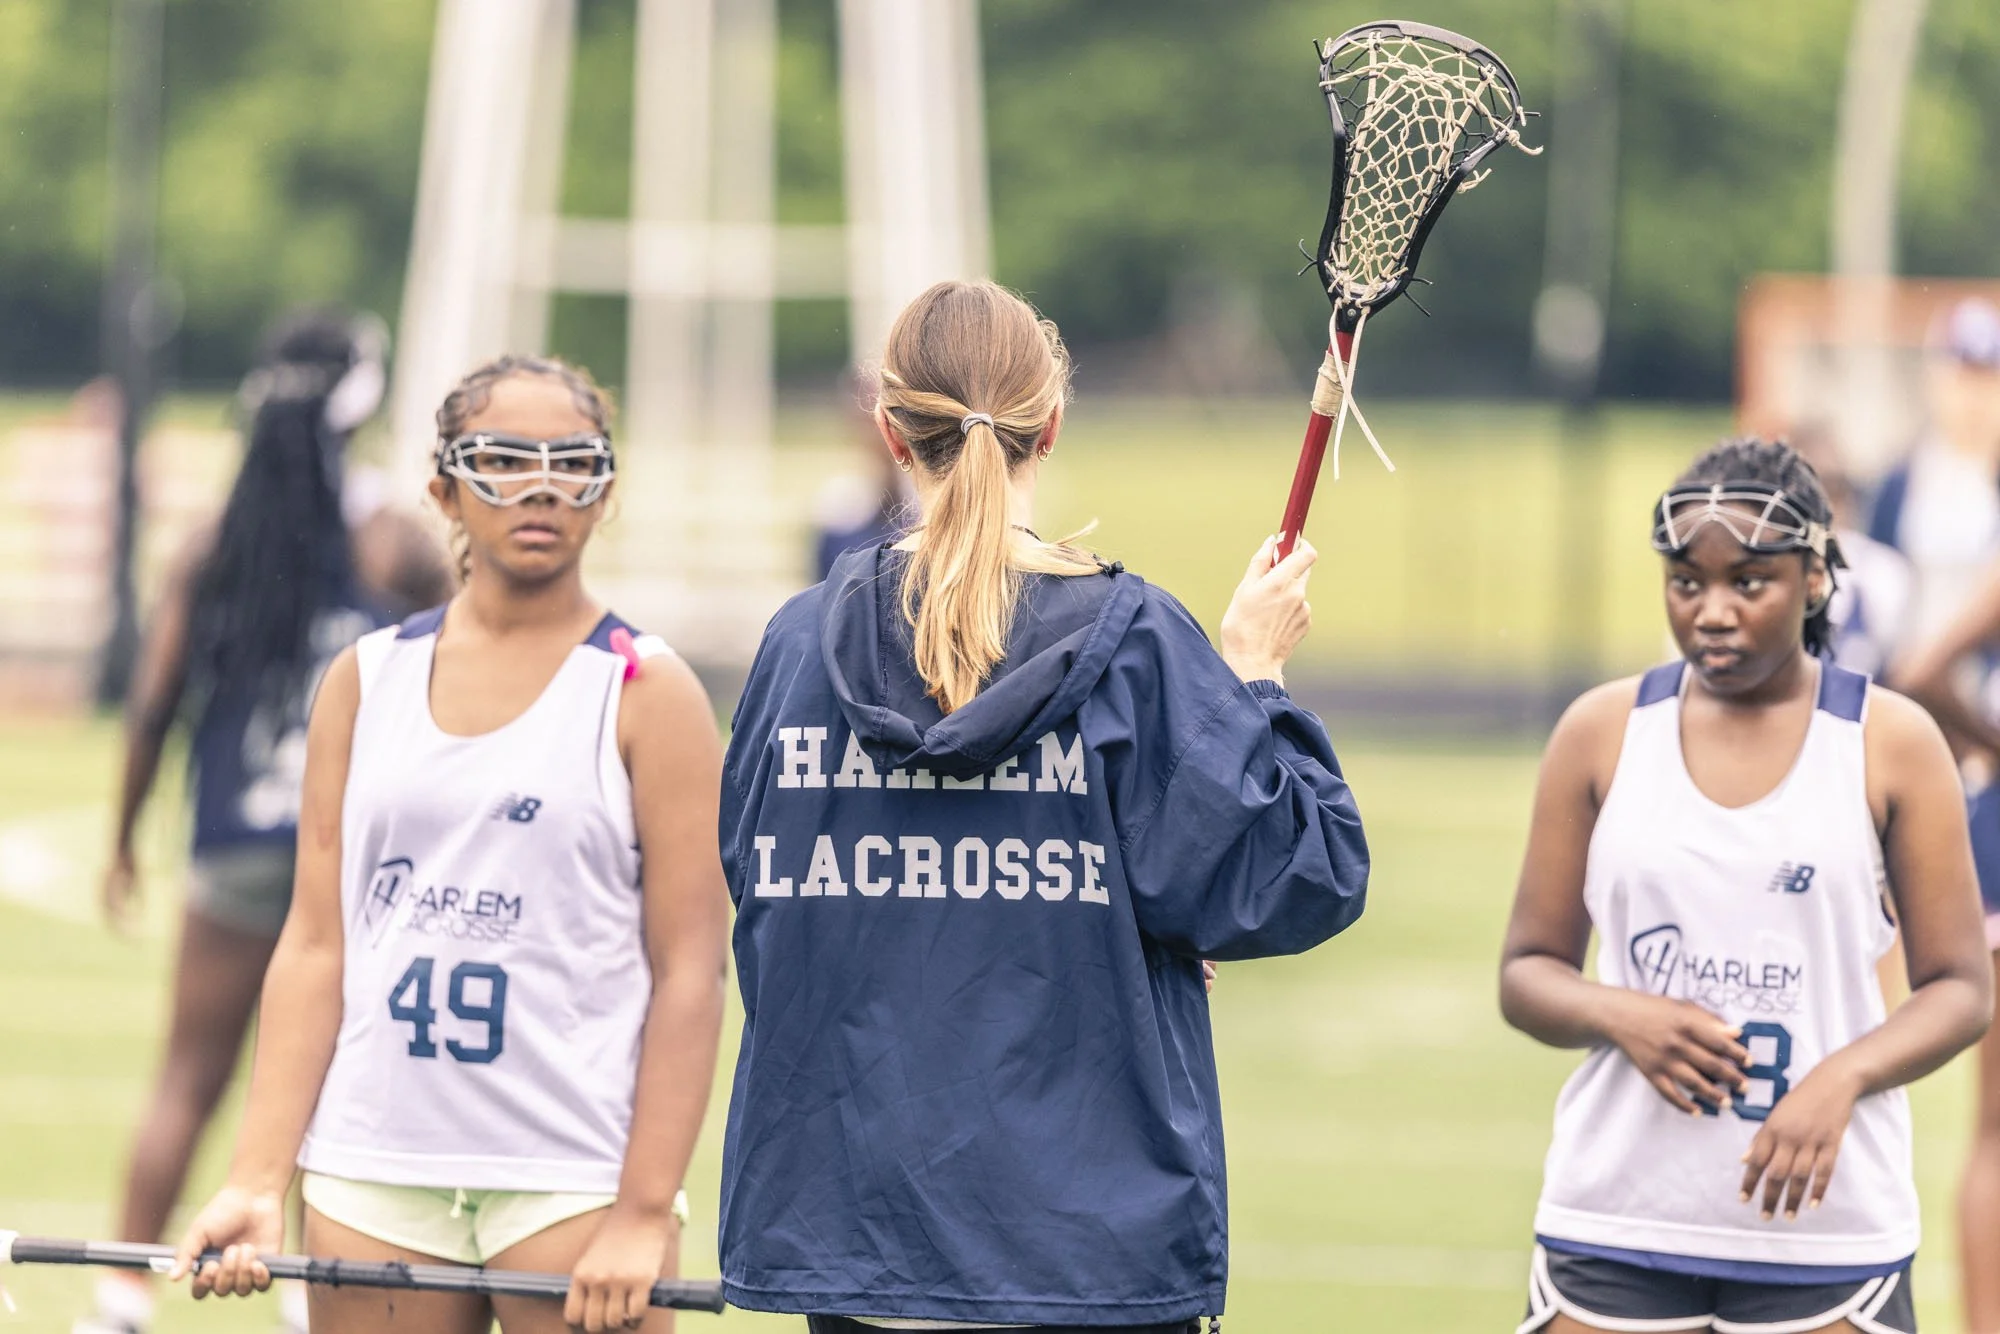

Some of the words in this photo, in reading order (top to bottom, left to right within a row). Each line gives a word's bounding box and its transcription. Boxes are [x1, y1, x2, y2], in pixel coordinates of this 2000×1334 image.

[777, 726, 1088, 796] HAEM
[409, 885, 522, 920] ARLEM
[754, 834, 1110, 906] LACROSSE
[388, 956, 508, 1064] 49
[1692, 1020, 1792, 1122] 8
